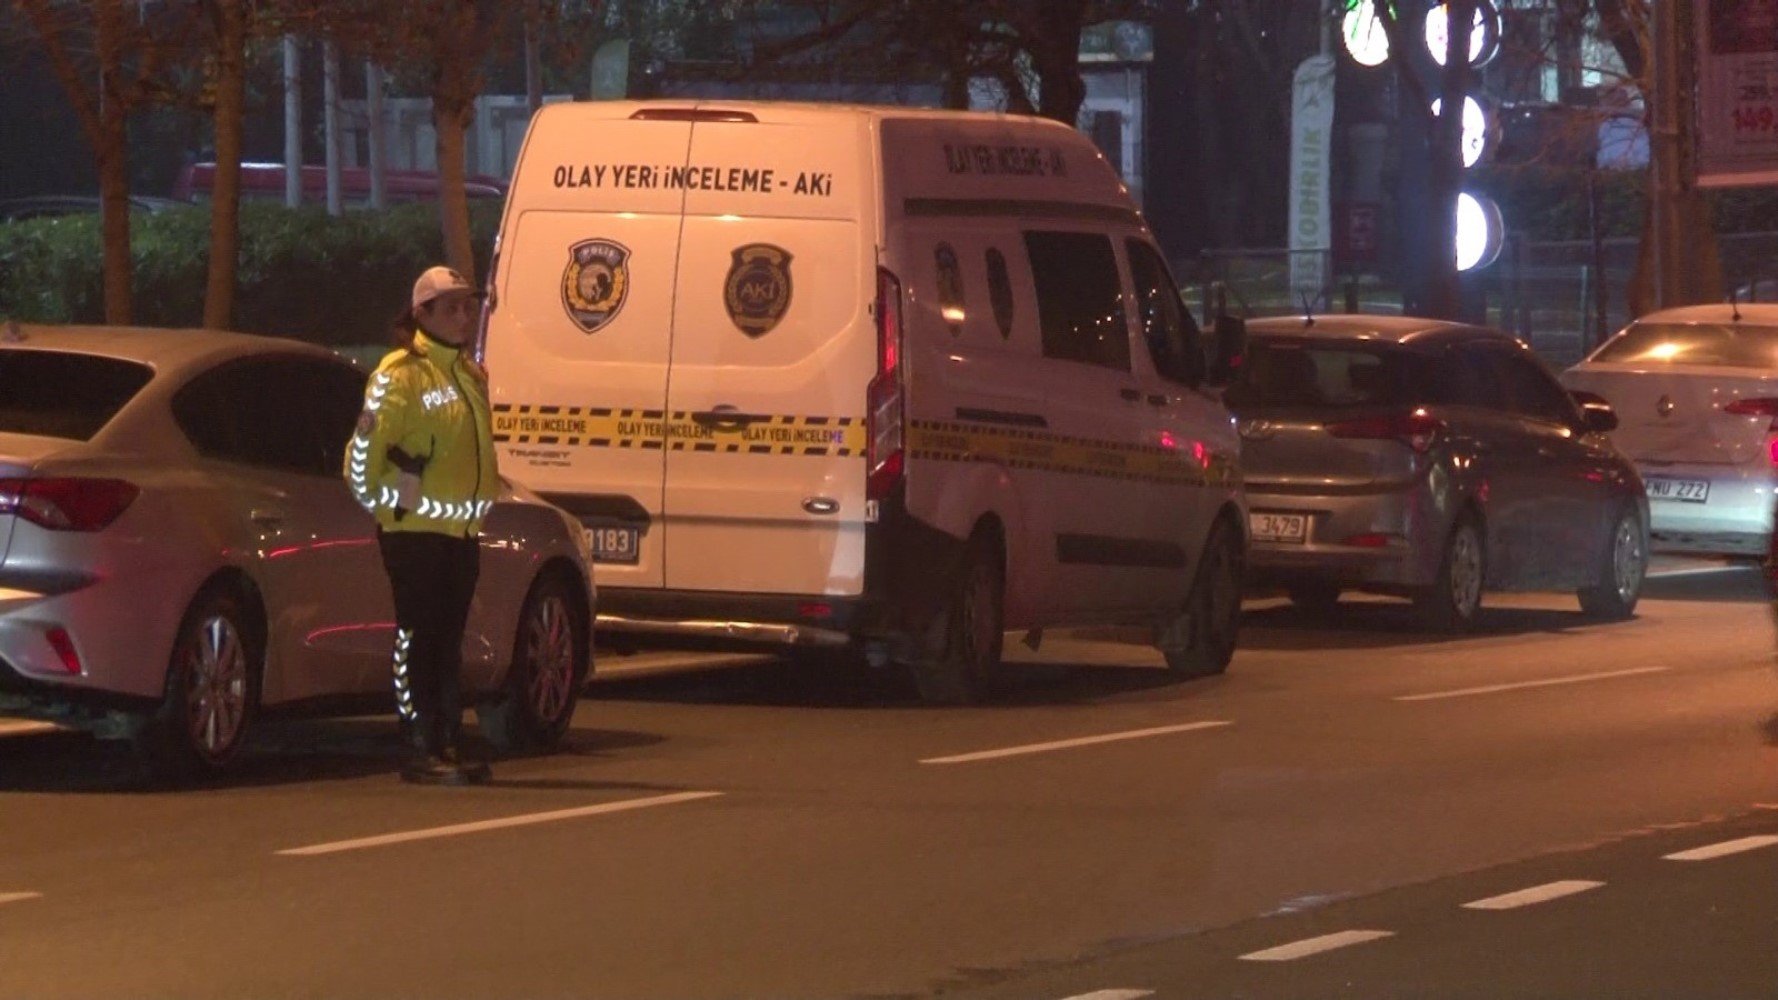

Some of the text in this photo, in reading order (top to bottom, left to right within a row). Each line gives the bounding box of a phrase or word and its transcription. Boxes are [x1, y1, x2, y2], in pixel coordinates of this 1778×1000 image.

[554, 165, 606, 188] OLAY
[497, 417, 518, 431] OLAY
[617, 421, 641, 435] OLAY
[741, 427, 766, 441] OLAY
[1677, 481, 1704, 497] 272
[1261, 516, 1300, 534] 3479
